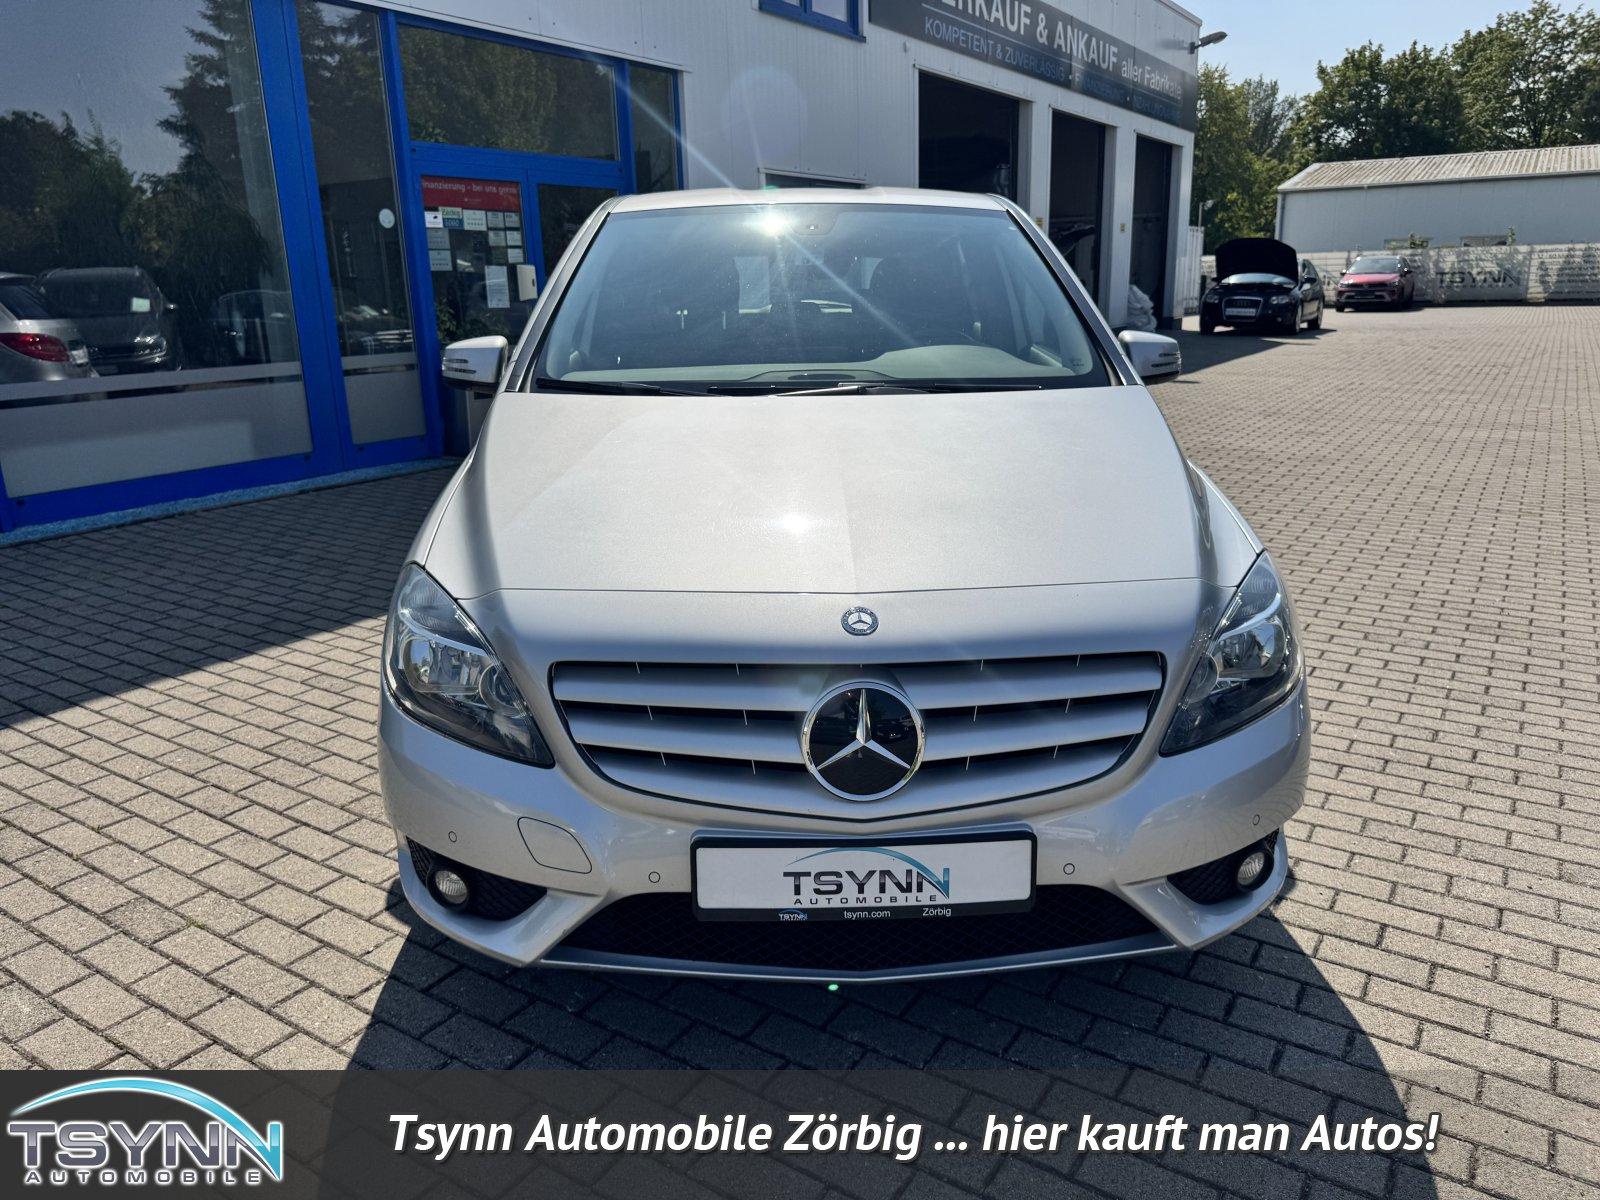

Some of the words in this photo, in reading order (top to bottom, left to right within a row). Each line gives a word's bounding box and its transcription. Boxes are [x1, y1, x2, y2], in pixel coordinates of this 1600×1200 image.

[924, 16, 995, 56] KOMPETENT
[996, 43, 1003, 60] &
[941, 0, 1031, 35] KAUF
[1036, 13, 1048, 45] &
[1054, 24, 1118, 71] ANKAUF
[1121, 57, 1142, 82] aller
[1144, 65, 1182, 100] Fabrikate
[783, 867, 950, 898] TSYNN
[793, 895, 937, 906] AUTOMOBILE
[844, 909, 891, 920] tsynn.com
[922, 906, 952, 917] Zörbig
